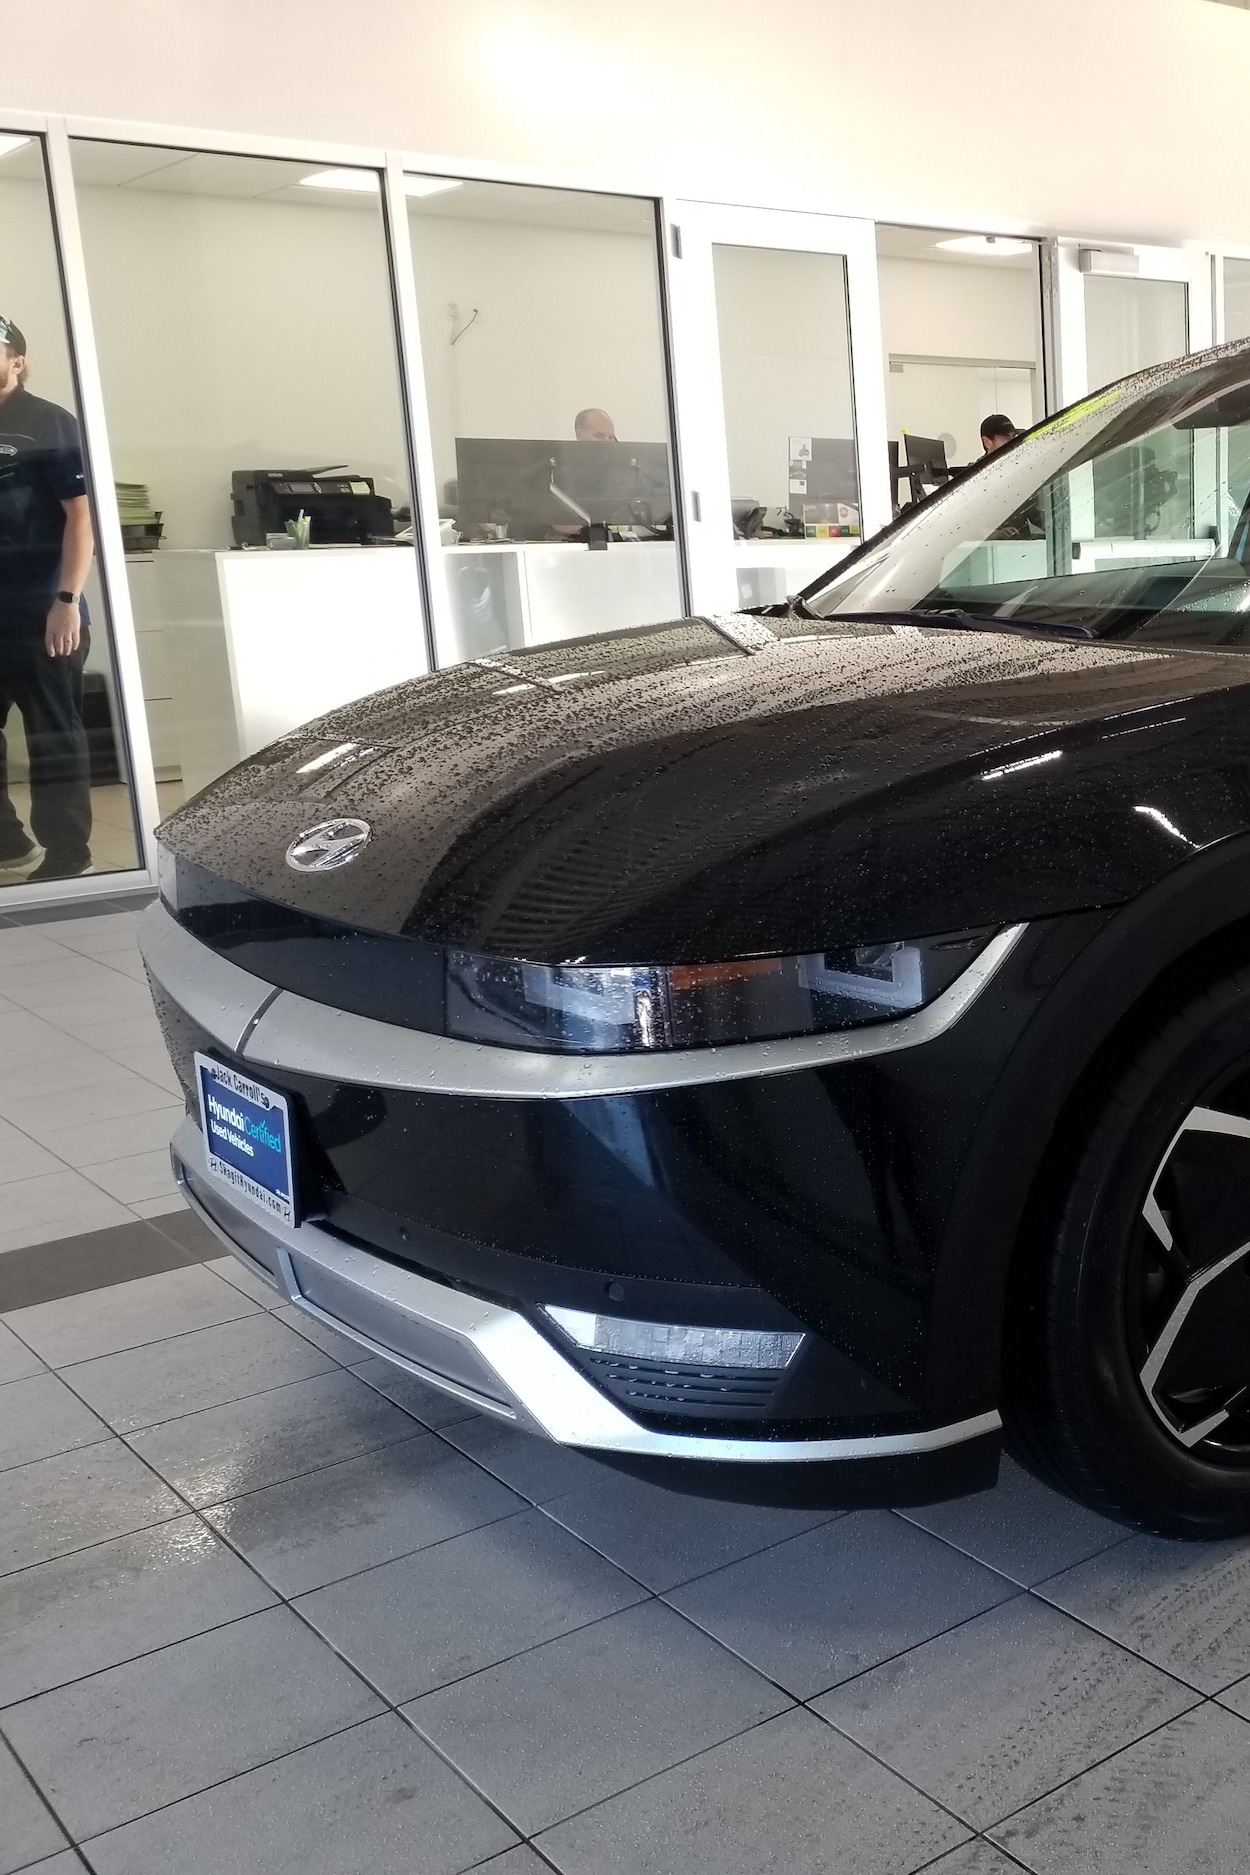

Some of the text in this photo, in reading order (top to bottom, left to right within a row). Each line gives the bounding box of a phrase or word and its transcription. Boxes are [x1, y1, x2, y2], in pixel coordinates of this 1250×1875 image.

[216, 1065, 265, 1104] Jack Carroll's
[207, 1094, 282, 1153] Hyundai Certified
[210, 1119, 254, 1157] Used Vehicles
[219, 1161, 282, 1213] SkagitHyundai.com
